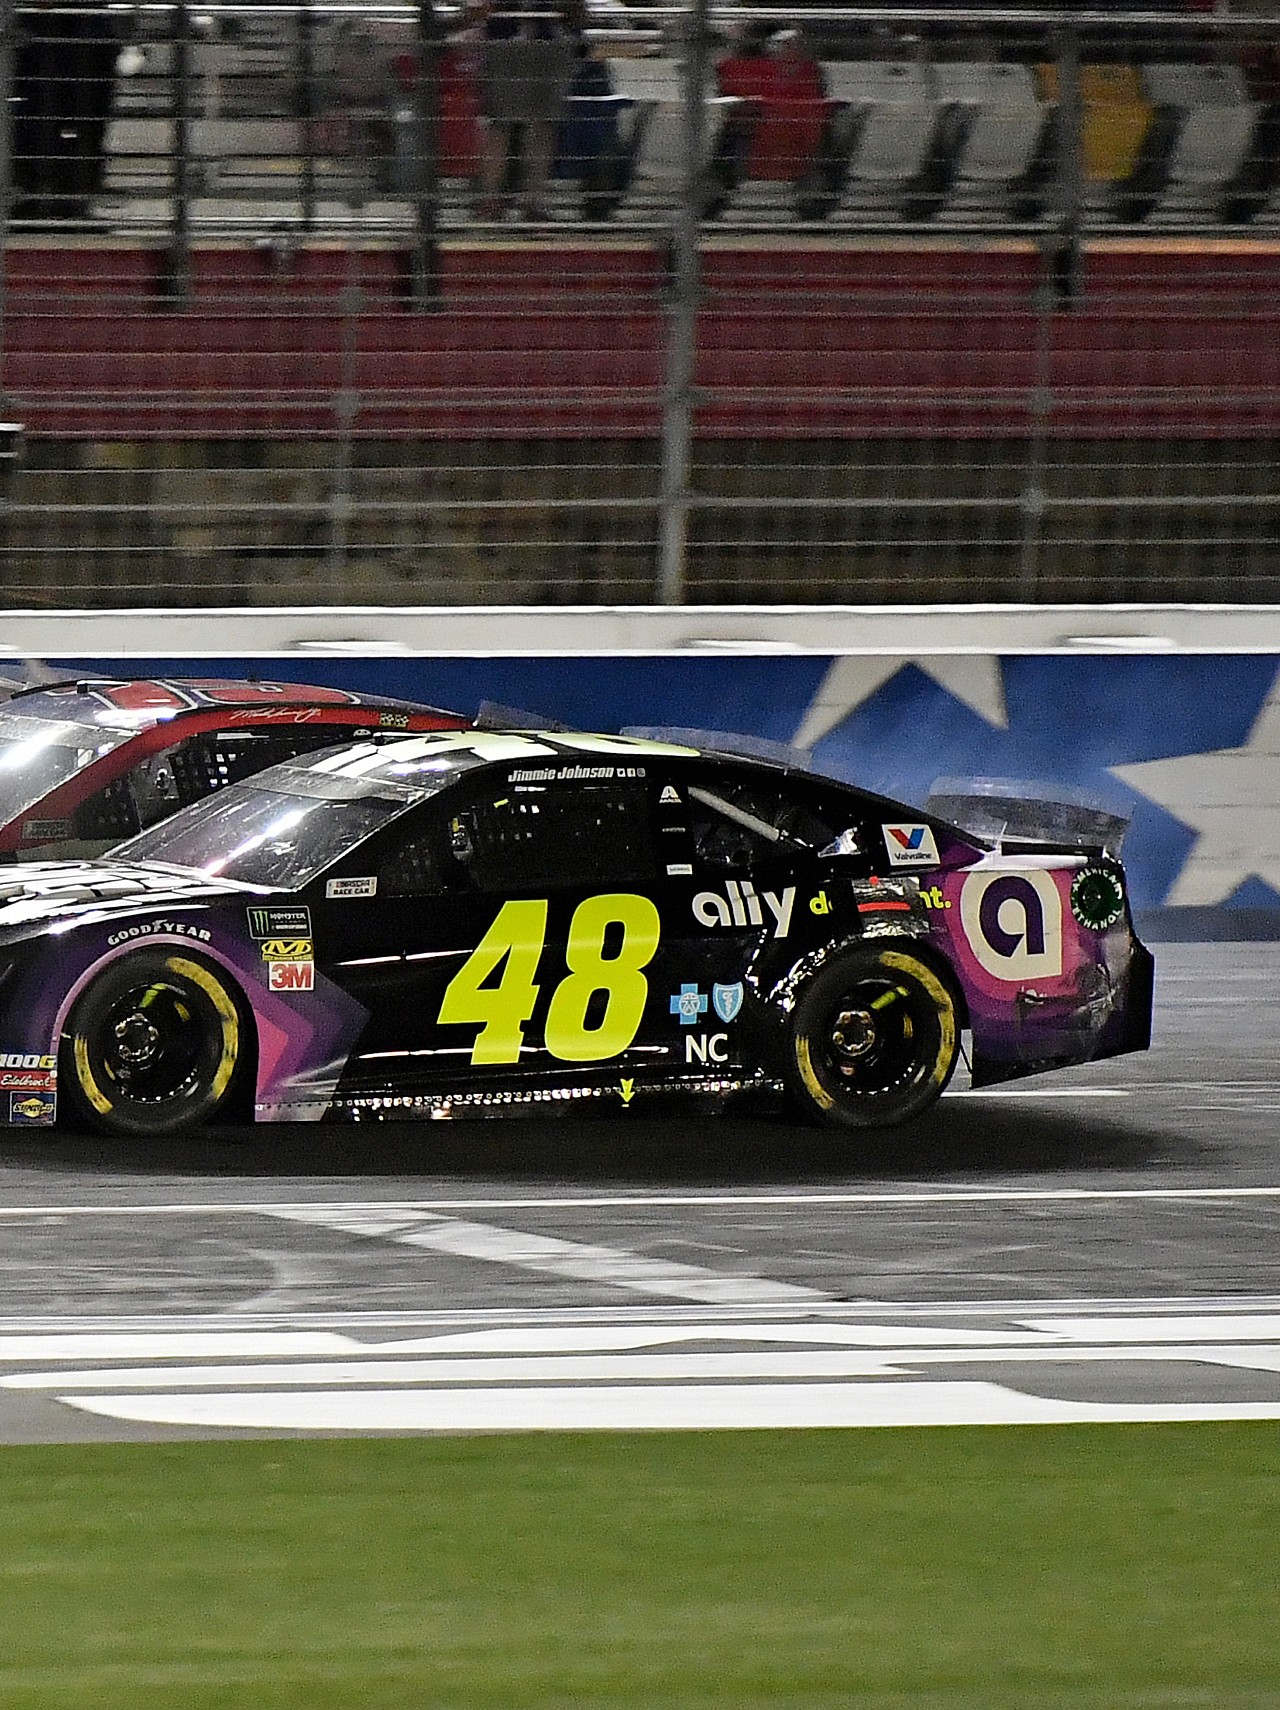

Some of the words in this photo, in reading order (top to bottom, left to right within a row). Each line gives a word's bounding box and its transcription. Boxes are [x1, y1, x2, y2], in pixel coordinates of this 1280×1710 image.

[508, 768, 556, 782] Jimmie
[557, 765, 614, 779] Johnson
[692, 880, 796, 939] ally
[1072, 906, 1121, 930] ETHANOL
[107, 919, 212, 946] GOODYEAR
[271, 963, 313, 988] 3M
[437, 893, 661, 1065] 48
[685, 1033, 728, 1062] NC
